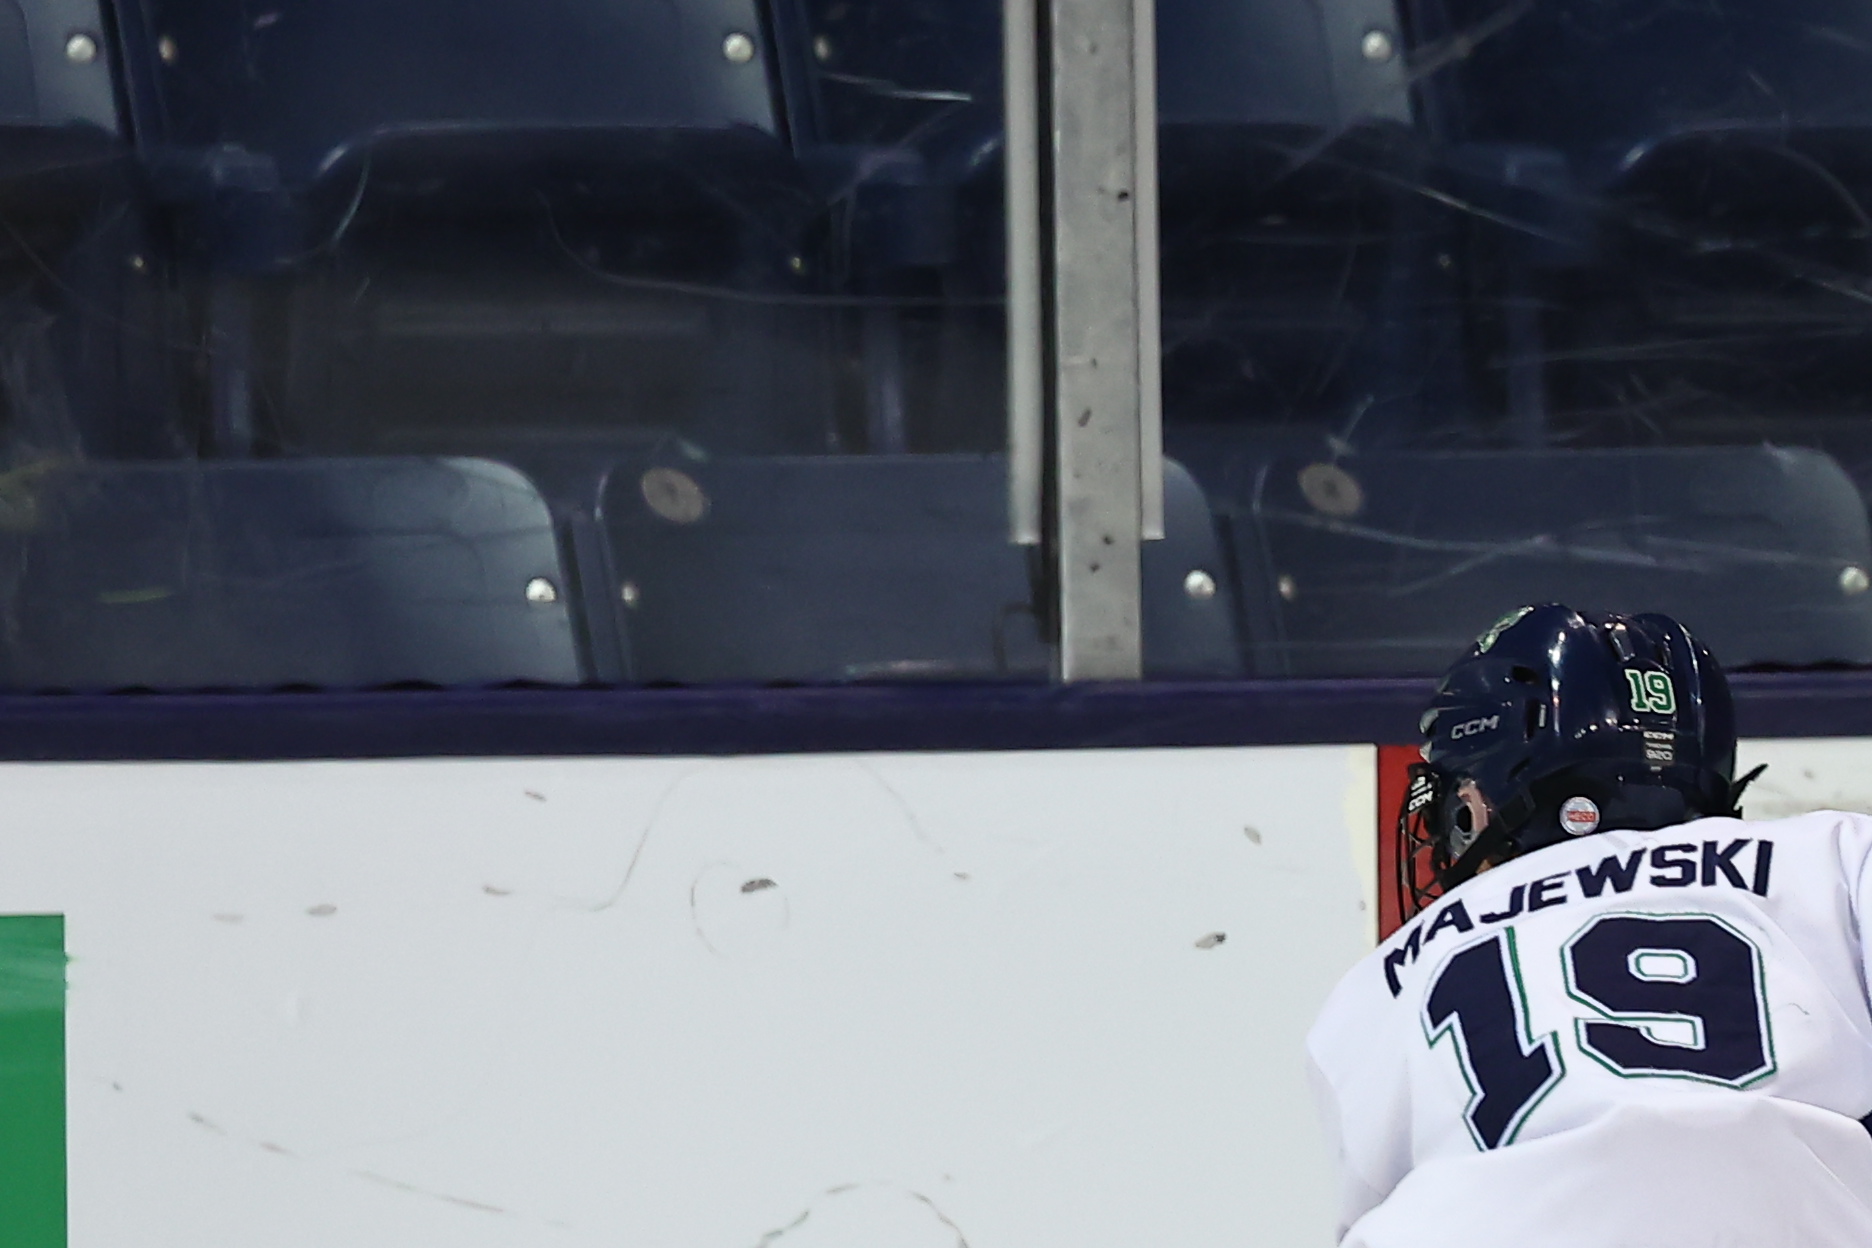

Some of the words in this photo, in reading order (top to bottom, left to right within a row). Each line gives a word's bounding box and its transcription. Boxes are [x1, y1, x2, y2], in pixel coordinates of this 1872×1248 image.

[1450, 714, 1501, 741] CCM
[1624, 668, 1677, 715] 19
[1381, 837, 1774, 998] MAJEWSKI
[1420, 910, 1776, 1153] 19
